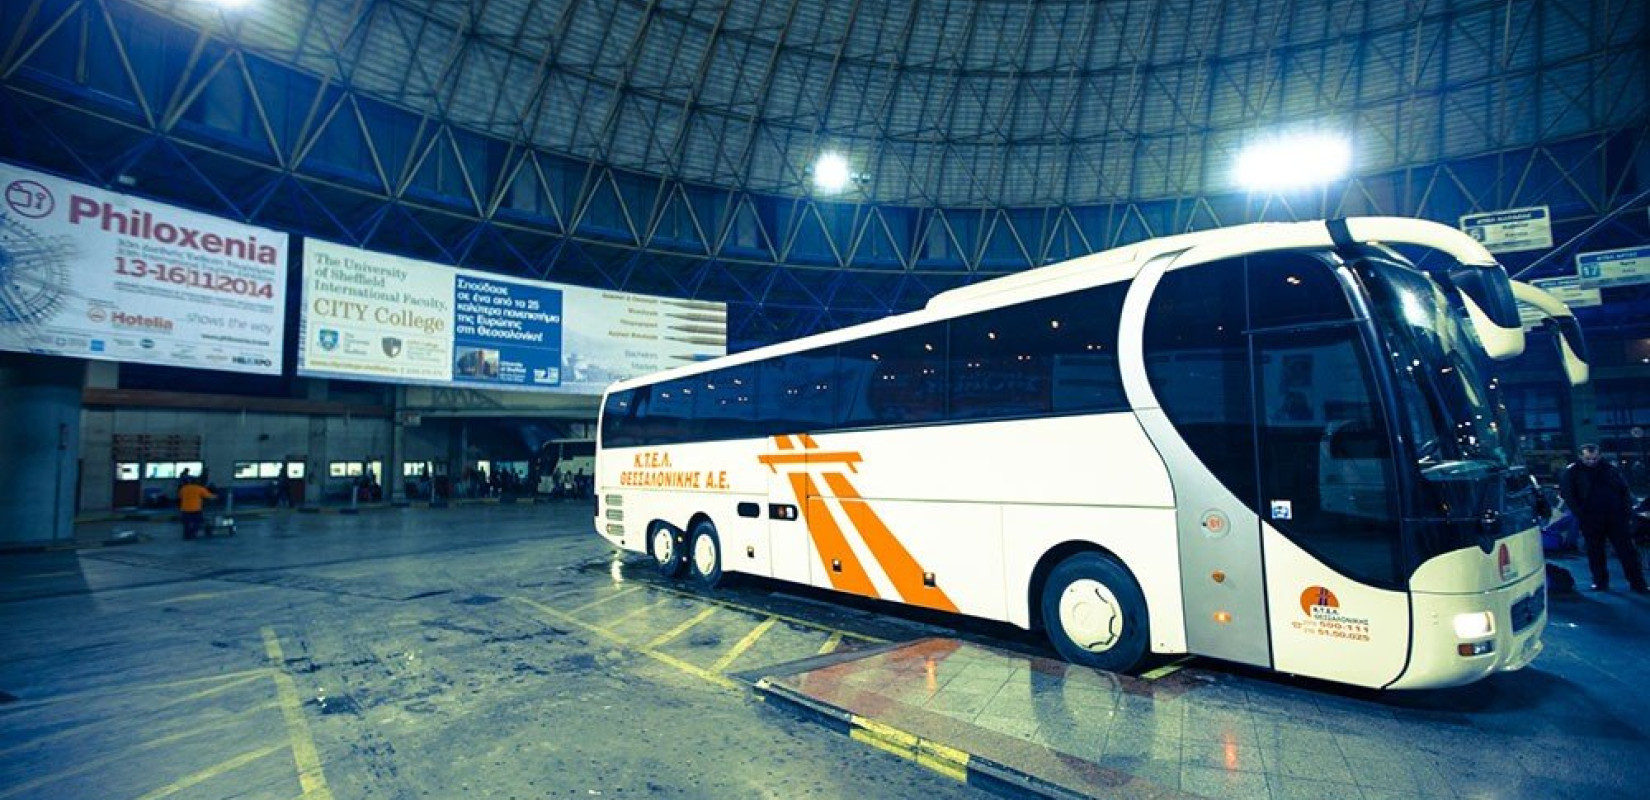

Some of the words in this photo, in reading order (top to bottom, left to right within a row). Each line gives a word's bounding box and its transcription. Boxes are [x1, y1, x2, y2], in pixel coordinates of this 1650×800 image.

[68, 194, 277, 266] Philoxenia
[315, 252, 342, 266] The
[344, 258, 407, 281] University
[315, 267, 328, 278] of
[330, 269, 386, 288] Sheffield
[315, 279, 400, 302] International
[111, 311, 174, 330] Hotelia
[314, 298, 369, 321] CITY
[374, 306, 445, 334] College
[620, 471, 701, 488] ΘΕΣΣΑΛΟΝΙΚΗΣ
[706, 470, 730, 489] Α.Ε.
